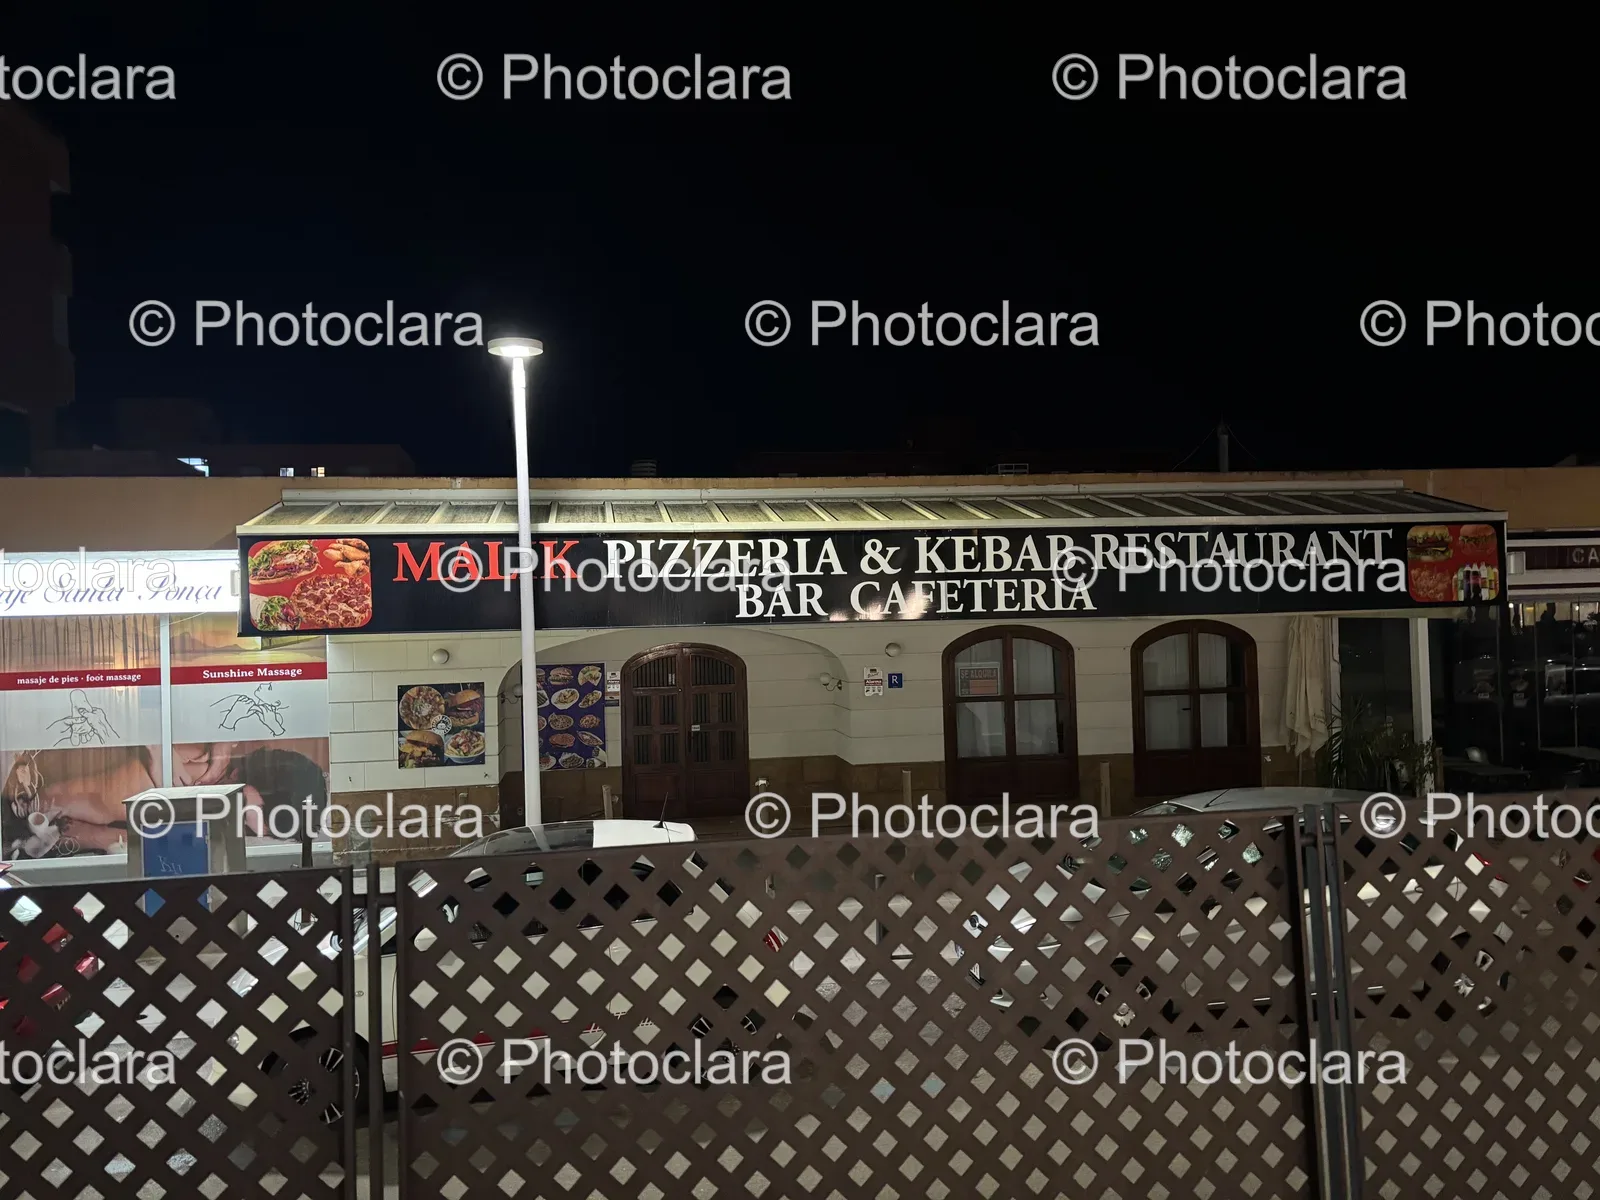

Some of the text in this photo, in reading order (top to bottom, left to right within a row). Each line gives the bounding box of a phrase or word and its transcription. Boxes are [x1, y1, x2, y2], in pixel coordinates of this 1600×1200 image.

[392, 528, 1393, 582] MALK PIZZERIA & KEBAB RESTAURANT
[735, 578, 1098, 618] BAR CAFETERIA
[17, 675, 47, 686] masaje
[49, 675, 59, 684] de
[61, 674, 79, 685] pies
[86, 673, 104, 682] foot
[106, 672, 142, 683] massage
[202, 667, 303, 679] Sunshine Massage
[891, 675, 899, 684] R
